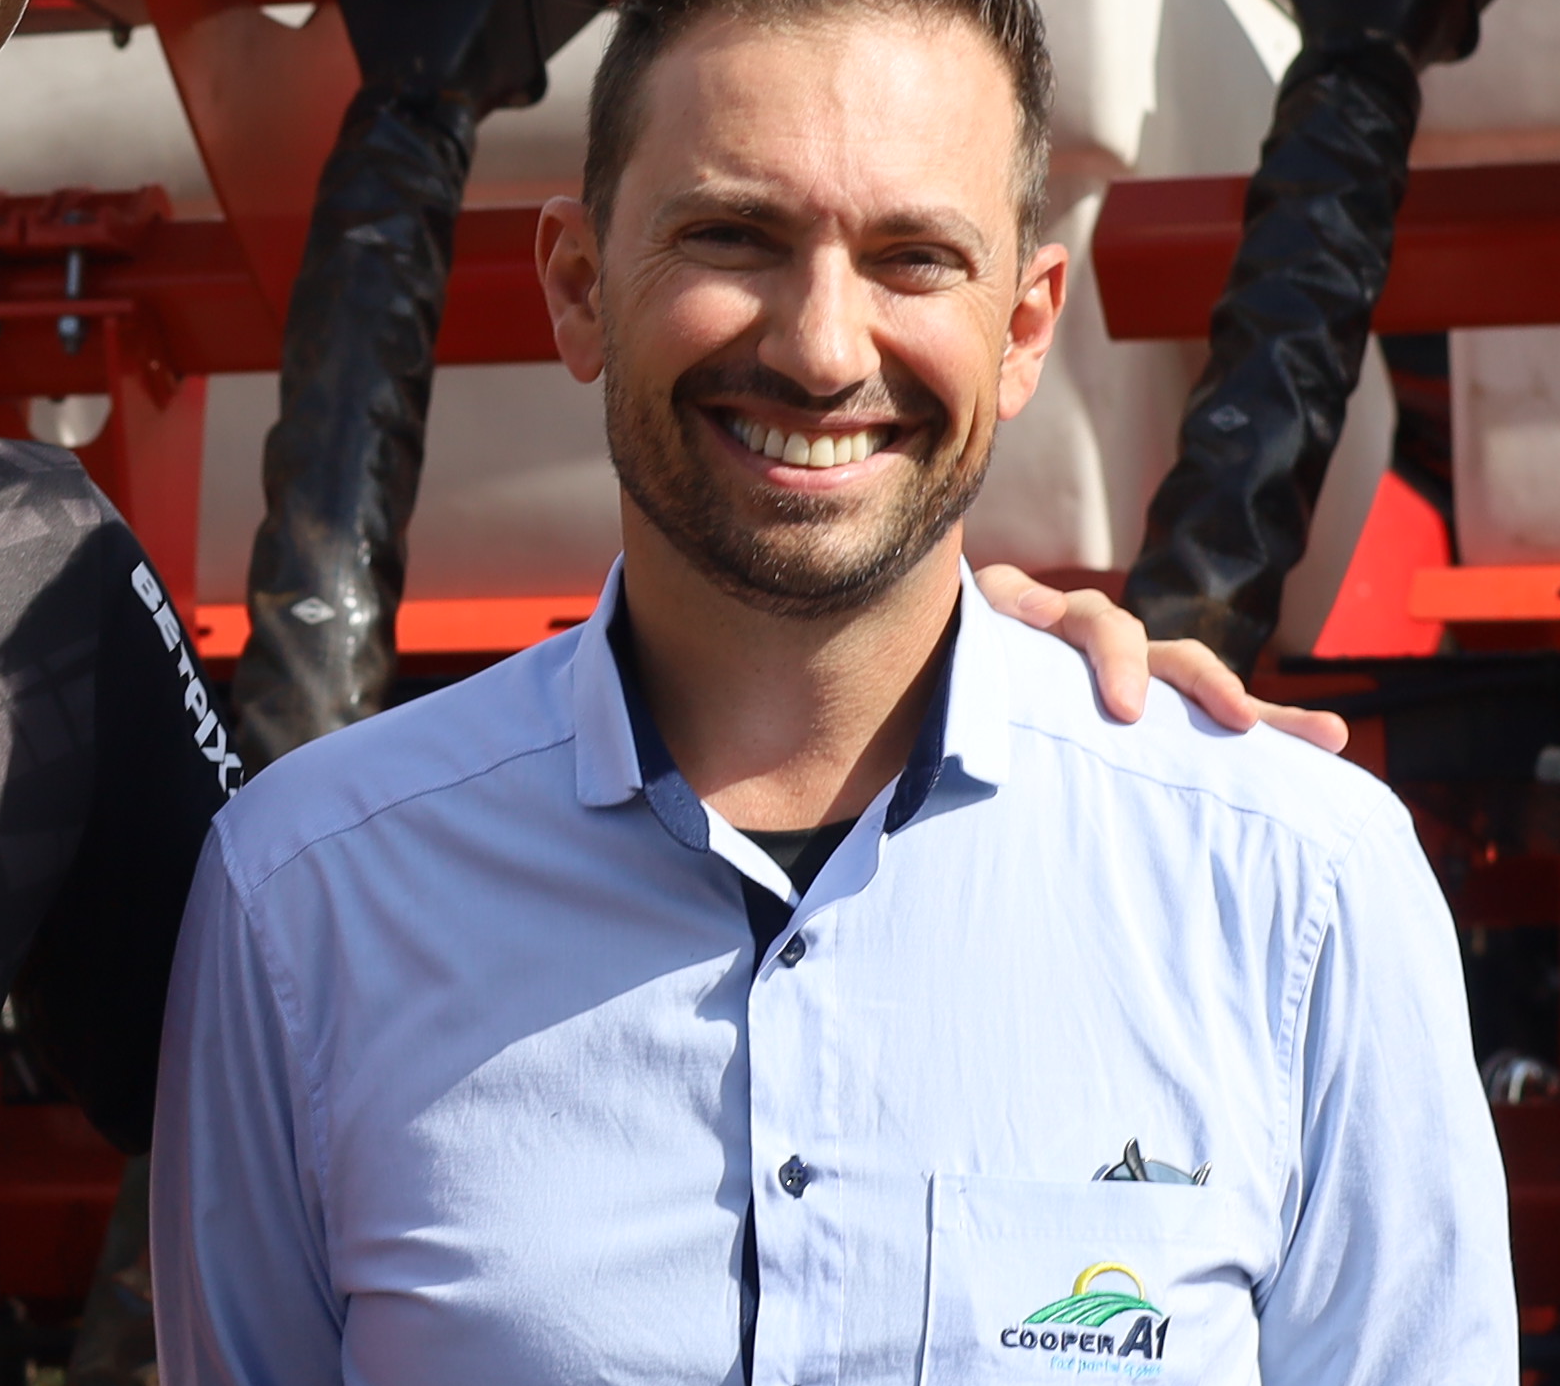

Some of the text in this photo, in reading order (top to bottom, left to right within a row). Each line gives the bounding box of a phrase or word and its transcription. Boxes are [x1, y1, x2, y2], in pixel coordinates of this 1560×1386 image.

[131, 561, 244, 799] BETPIX
[1000, 1314, 1172, 1360] COOPER A1
